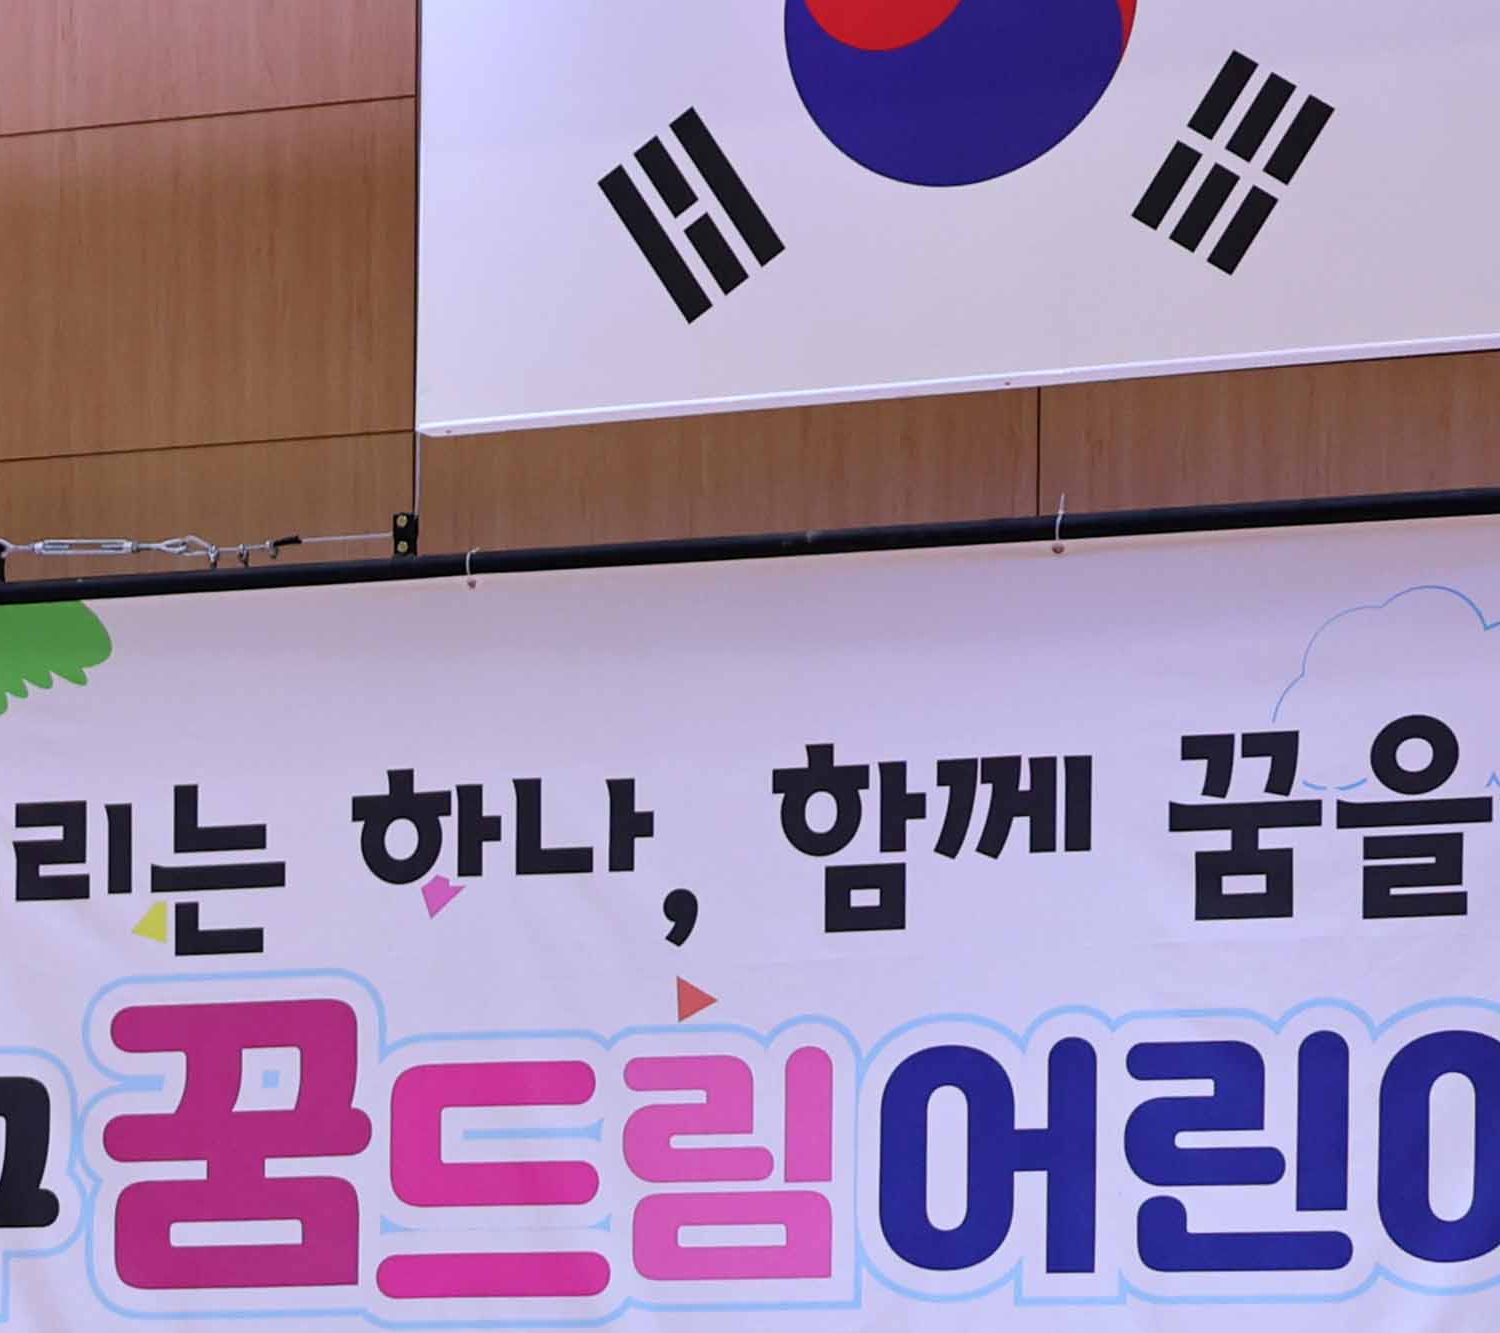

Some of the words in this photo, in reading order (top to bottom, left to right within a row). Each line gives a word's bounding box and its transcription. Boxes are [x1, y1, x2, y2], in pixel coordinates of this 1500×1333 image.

[351, 768, 701, 947] 하나,
[772, 743, 1093, 933] 함께
[1169, 713, 1494, 921] 꿈을
